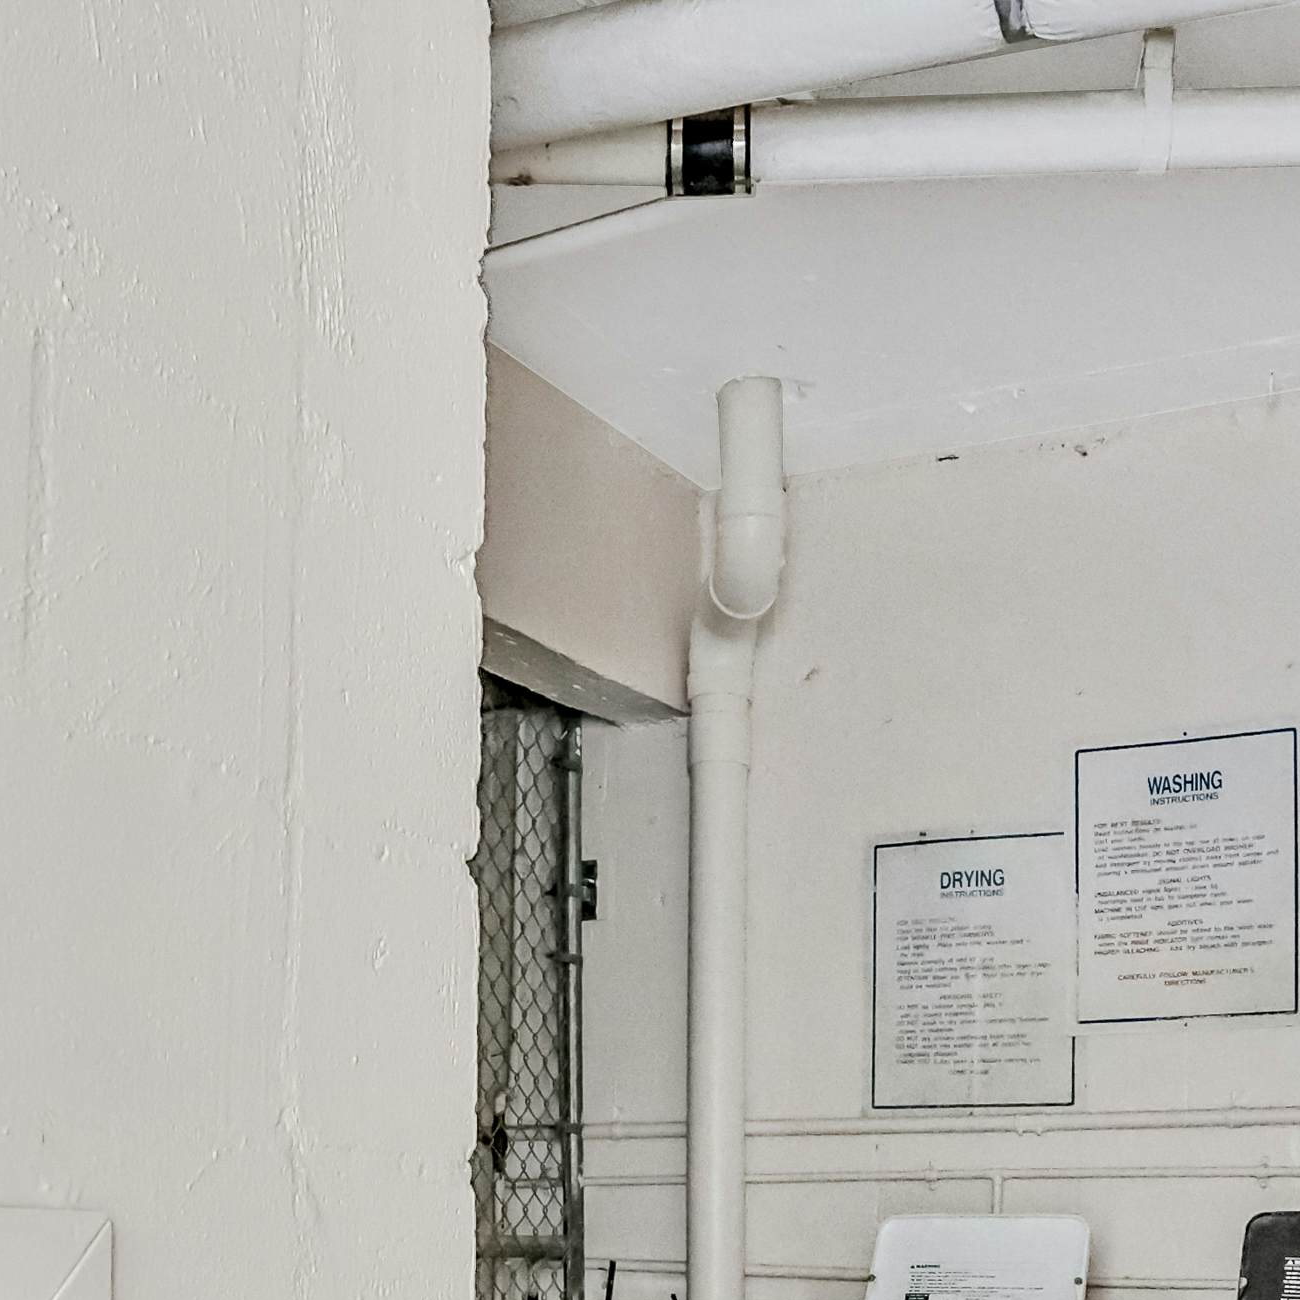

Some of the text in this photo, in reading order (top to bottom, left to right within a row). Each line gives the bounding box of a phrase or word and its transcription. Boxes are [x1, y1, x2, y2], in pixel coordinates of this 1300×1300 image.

[1147, 770, 1223, 795] WASHING
[1150, 792, 1219, 806] INSTRUCTIONS
[940, 868, 1005, 890] DRYING
